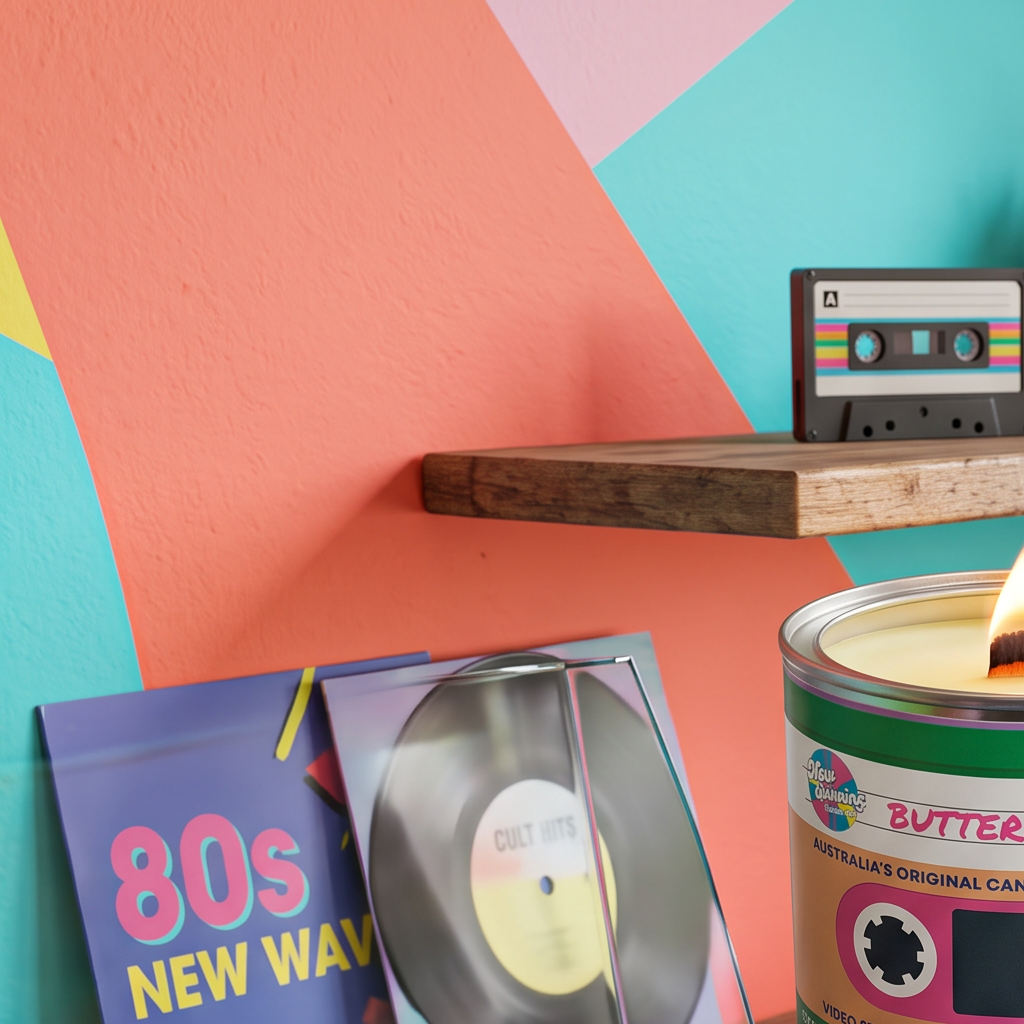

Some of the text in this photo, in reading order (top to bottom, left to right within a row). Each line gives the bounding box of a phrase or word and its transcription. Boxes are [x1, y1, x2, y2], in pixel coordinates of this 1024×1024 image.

[824, 291, 838, 307] A
[494, 815, 577, 852] CULT HITS
[110, 813, 310, 945] 80s
[814, 837, 893, 877] AUSTRALIA'S
[896, 867, 982, 891] ORIGINAL
[126, 913, 375, 1020] NEW WAV
